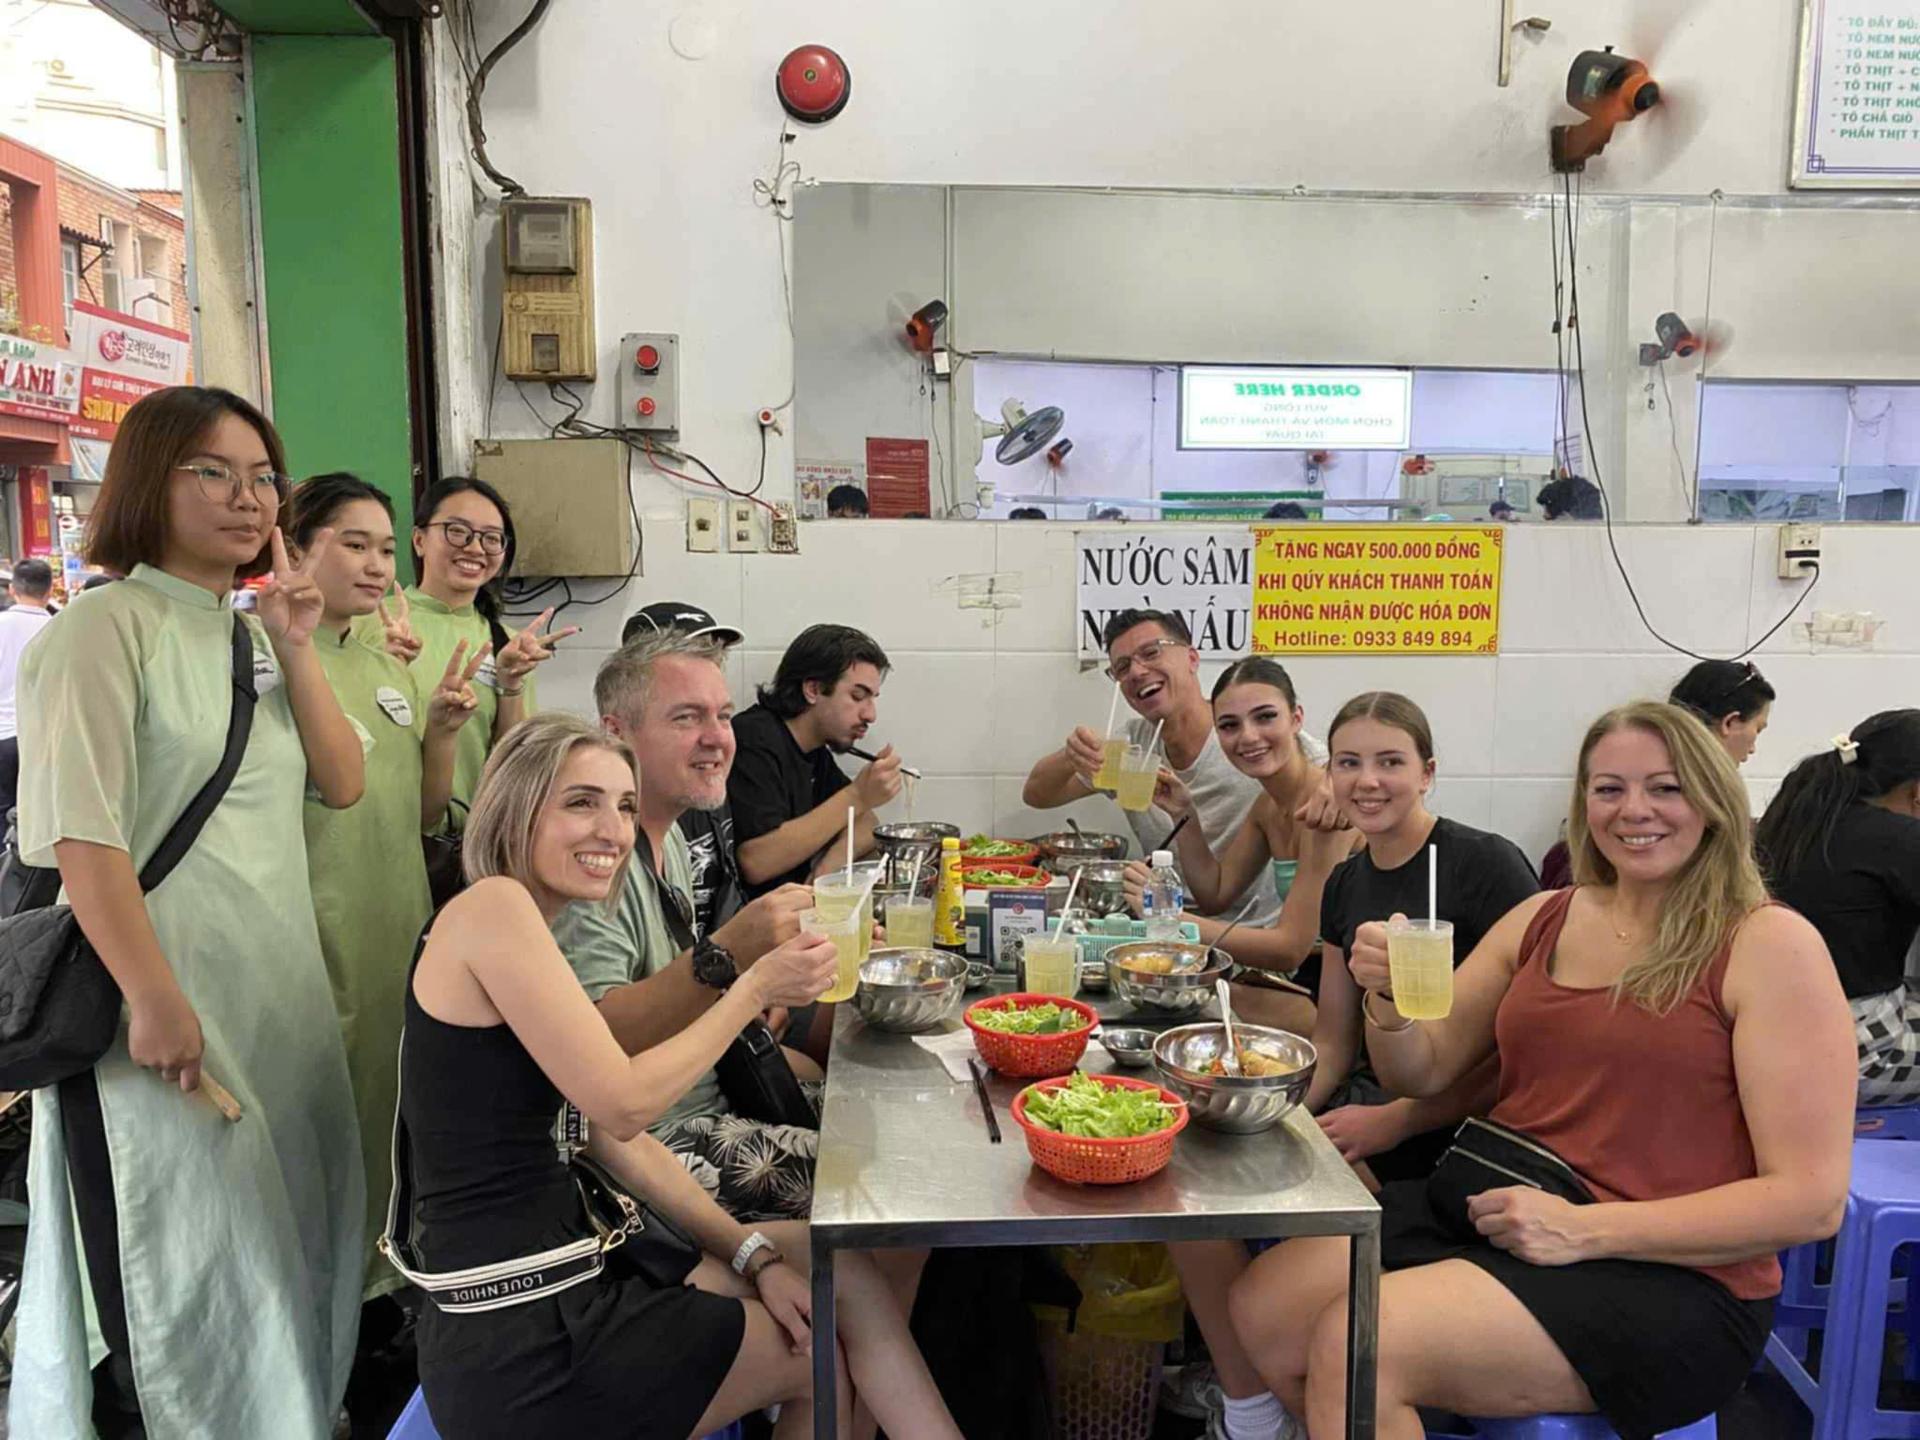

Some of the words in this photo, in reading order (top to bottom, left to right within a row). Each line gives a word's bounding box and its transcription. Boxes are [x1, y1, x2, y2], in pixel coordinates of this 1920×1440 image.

[12, 361, 55, 395] ANH
[1081, 536, 1174, 586] NƯỚC
[1183, 536, 1252, 586] SÂM
[1274, 540, 1318, 563] TẶNG
[1323, 542, 1366, 559] NGAY
[1369, 542, 1431, 559] 500.000
[1258, 573, 1286, 590] KHI
[1292, 569, 1324, 592] QÚY
[1328, 569, 1384, 590] KHÁCH
[1390, 573, 1444, 590] THANH
[1450, 569, 1493, 590] TOÁN
[1172, 596, 1251, 651] NẤU
[1257, 600, 1314, 620] KHÔNG
[1319, 600, 1364, 623] NHẬN
[1369, 601, 1414, 623] ĐƯỢC
[1419, 600, 1452, 620] HÓA
[1458, 602, 1491, 620] ĐƠN
[1274, 631, 1346, 646] Hotline:
[1353, 631, 1396, 646] 0933
[1402, 631, 1434, 646] 849
[1440, 631, 1472, 646] 894
[450, 1273, 544, 1303] LOUENHIDE
